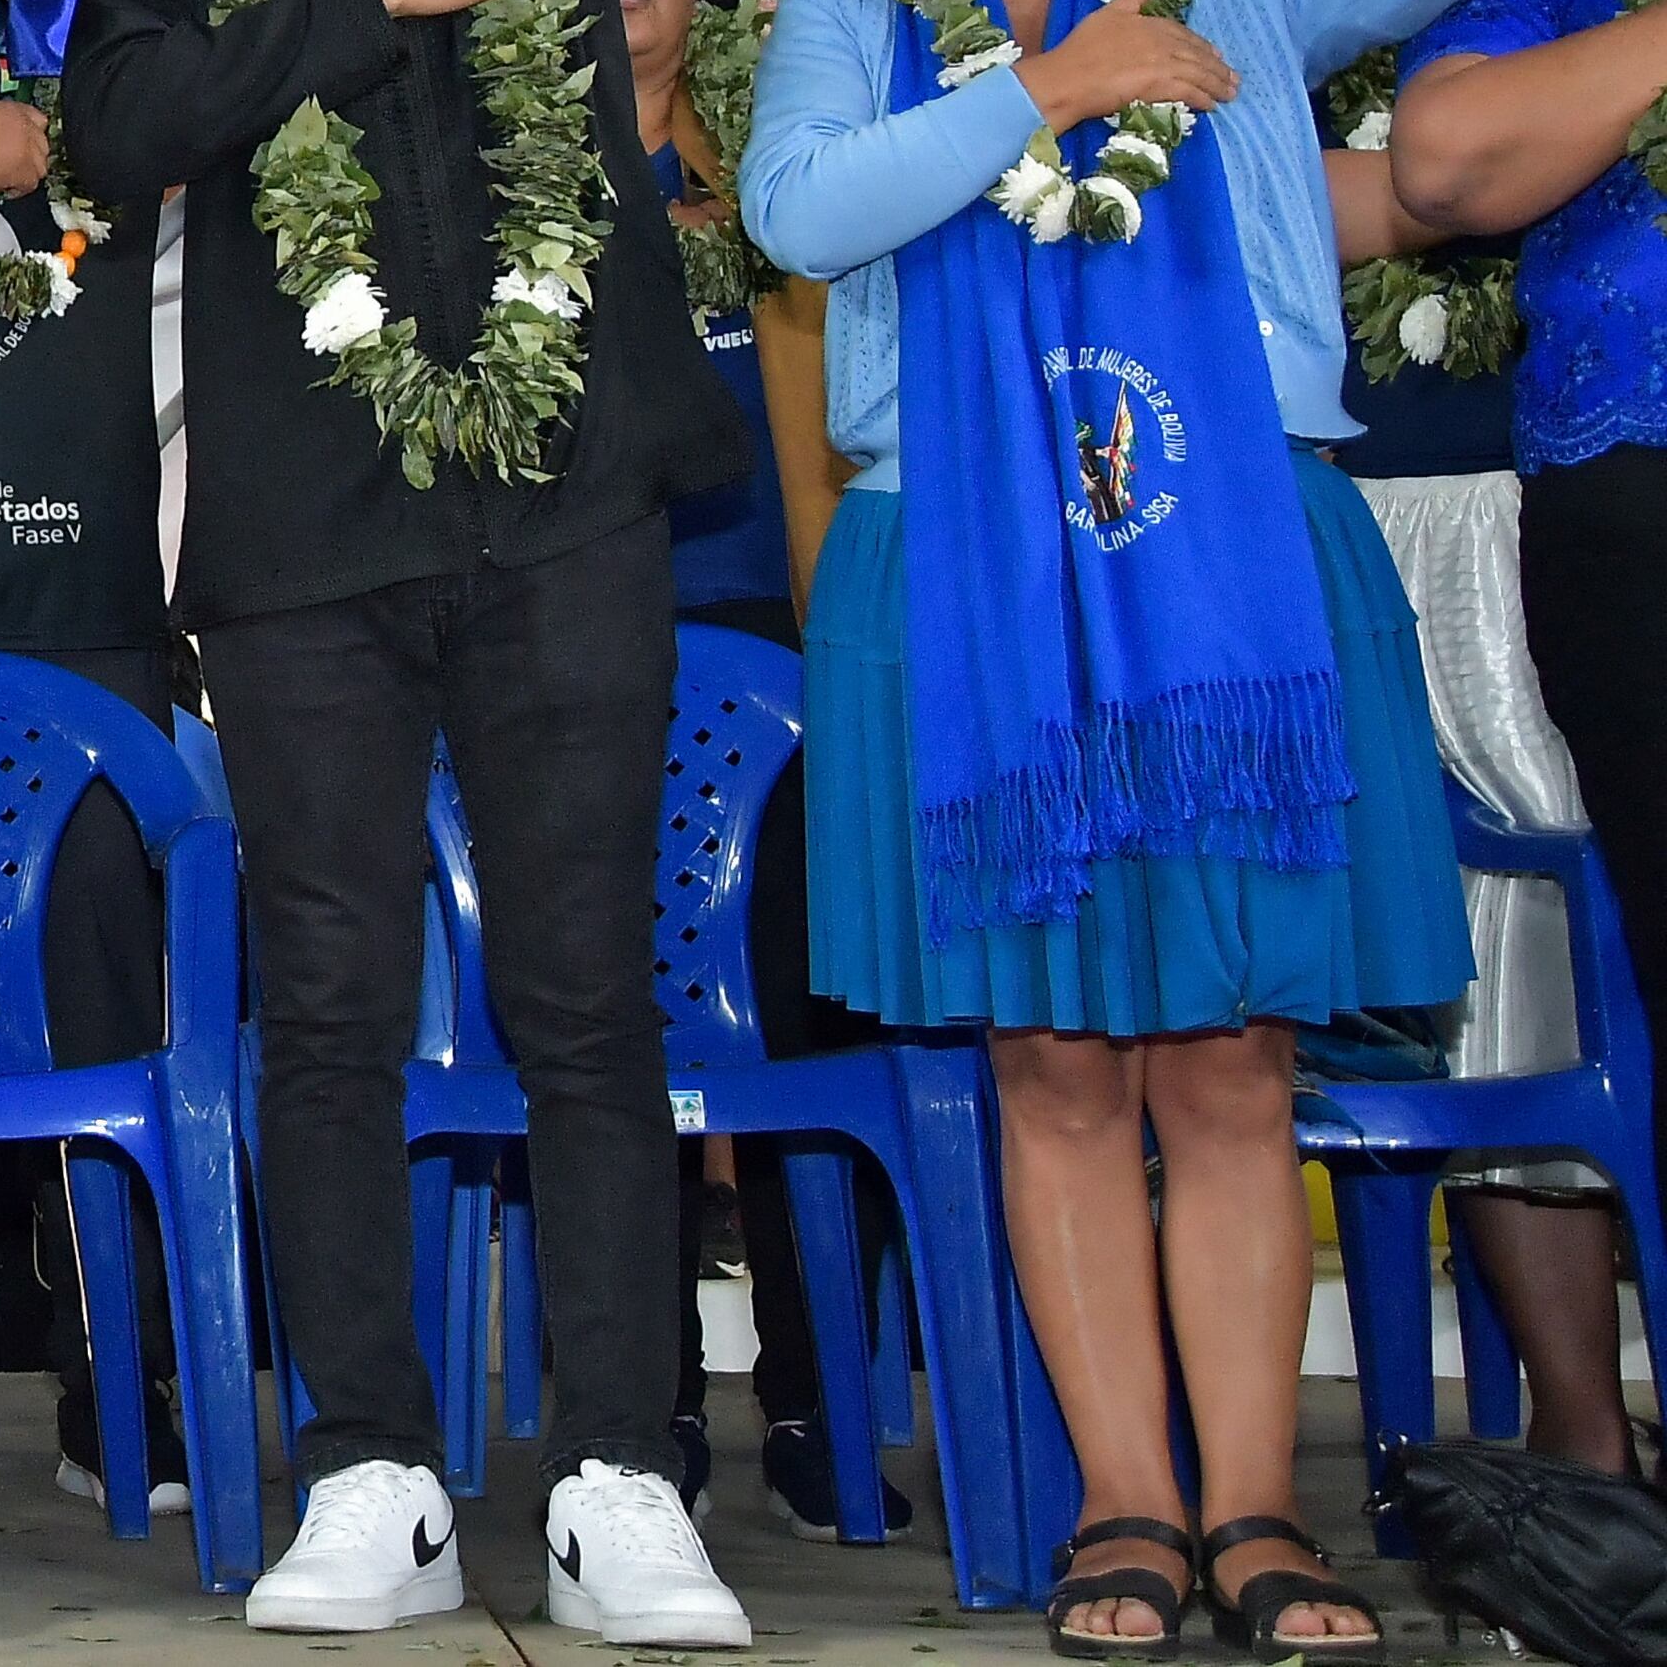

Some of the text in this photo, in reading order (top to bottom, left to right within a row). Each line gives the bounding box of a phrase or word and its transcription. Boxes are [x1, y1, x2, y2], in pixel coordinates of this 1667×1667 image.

[4, 330, 24, 349] DE
[1078, 347, 1095, 369] DE
[1095, 347, 1158, 396] MUJERES
[1157, 413, 1187, 463] BOLIVIA
[1141, 491, 1179, 525] SISA
[12, 523, 82, 545] Fase V
